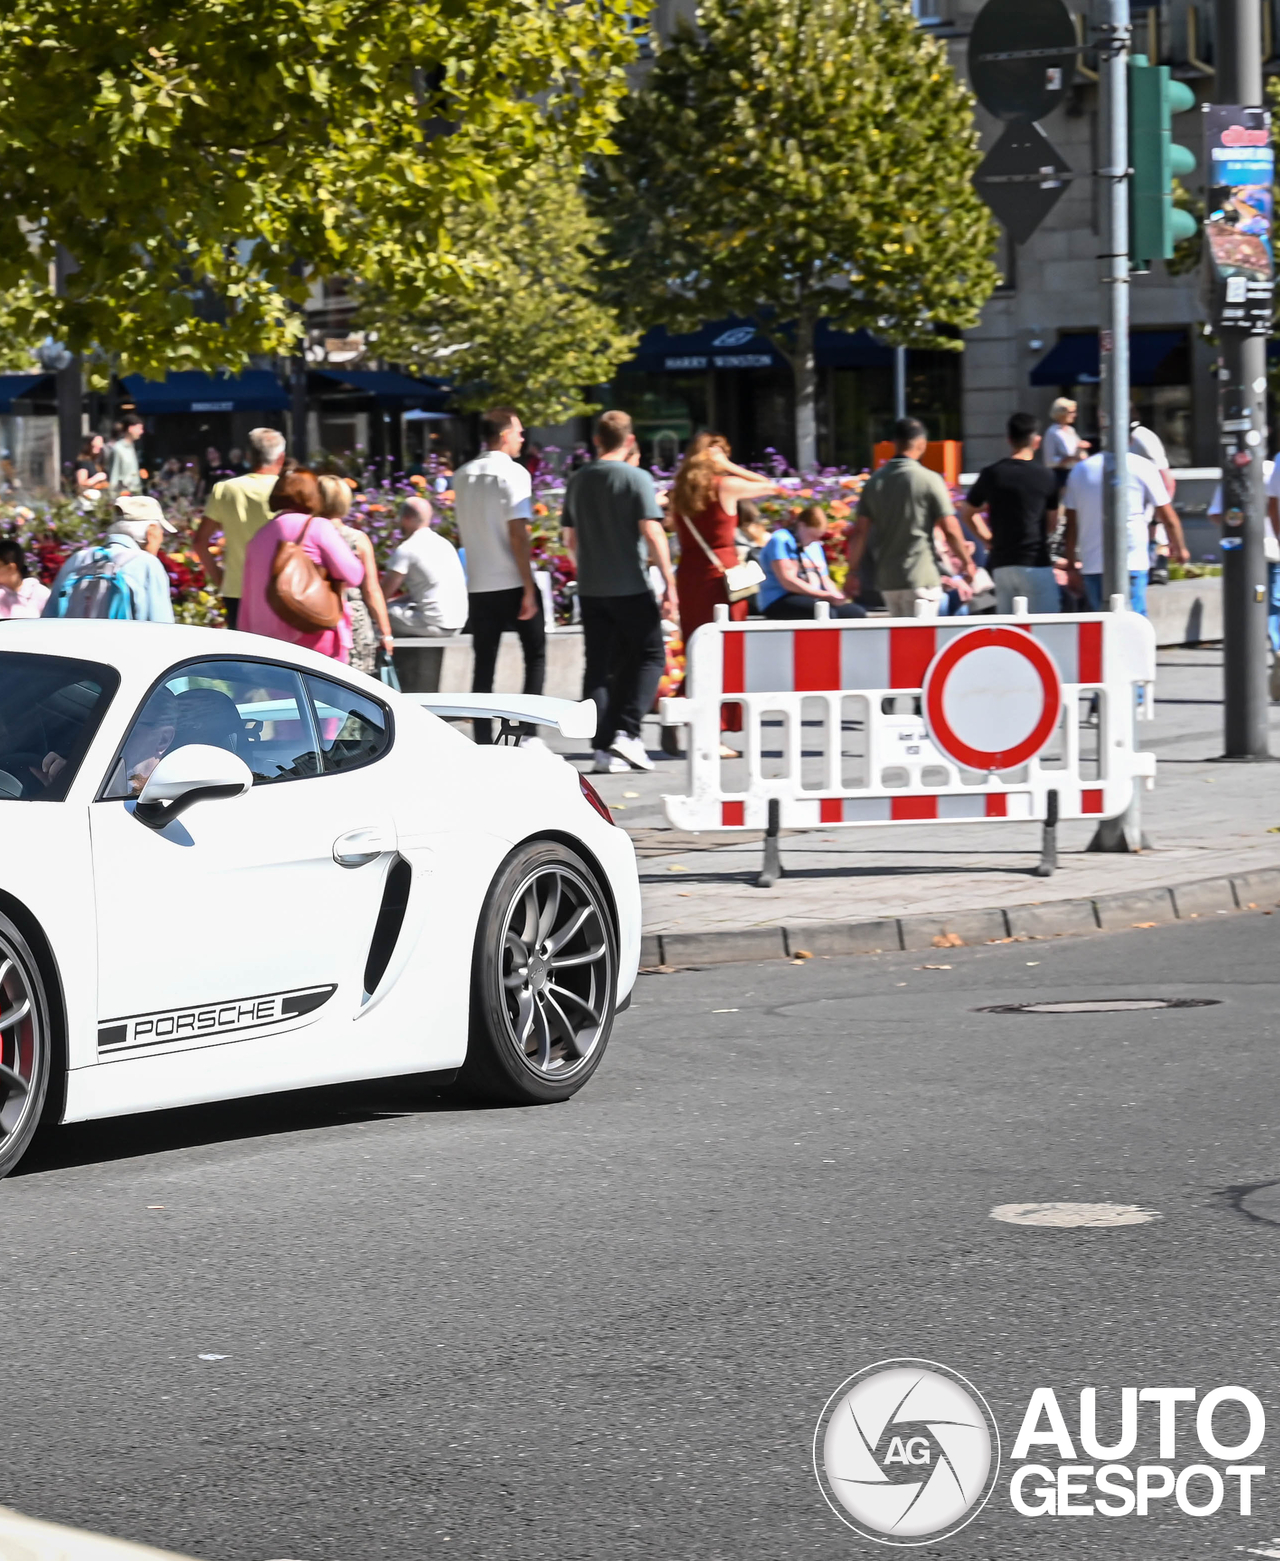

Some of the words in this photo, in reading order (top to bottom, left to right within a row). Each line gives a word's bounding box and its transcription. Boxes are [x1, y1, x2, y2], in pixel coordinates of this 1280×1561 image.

[664, 356, 708, 370] HARRY
[712, 354, 773, 368] WINSTON
[133, 999, 276, 1041] PORSCHE
